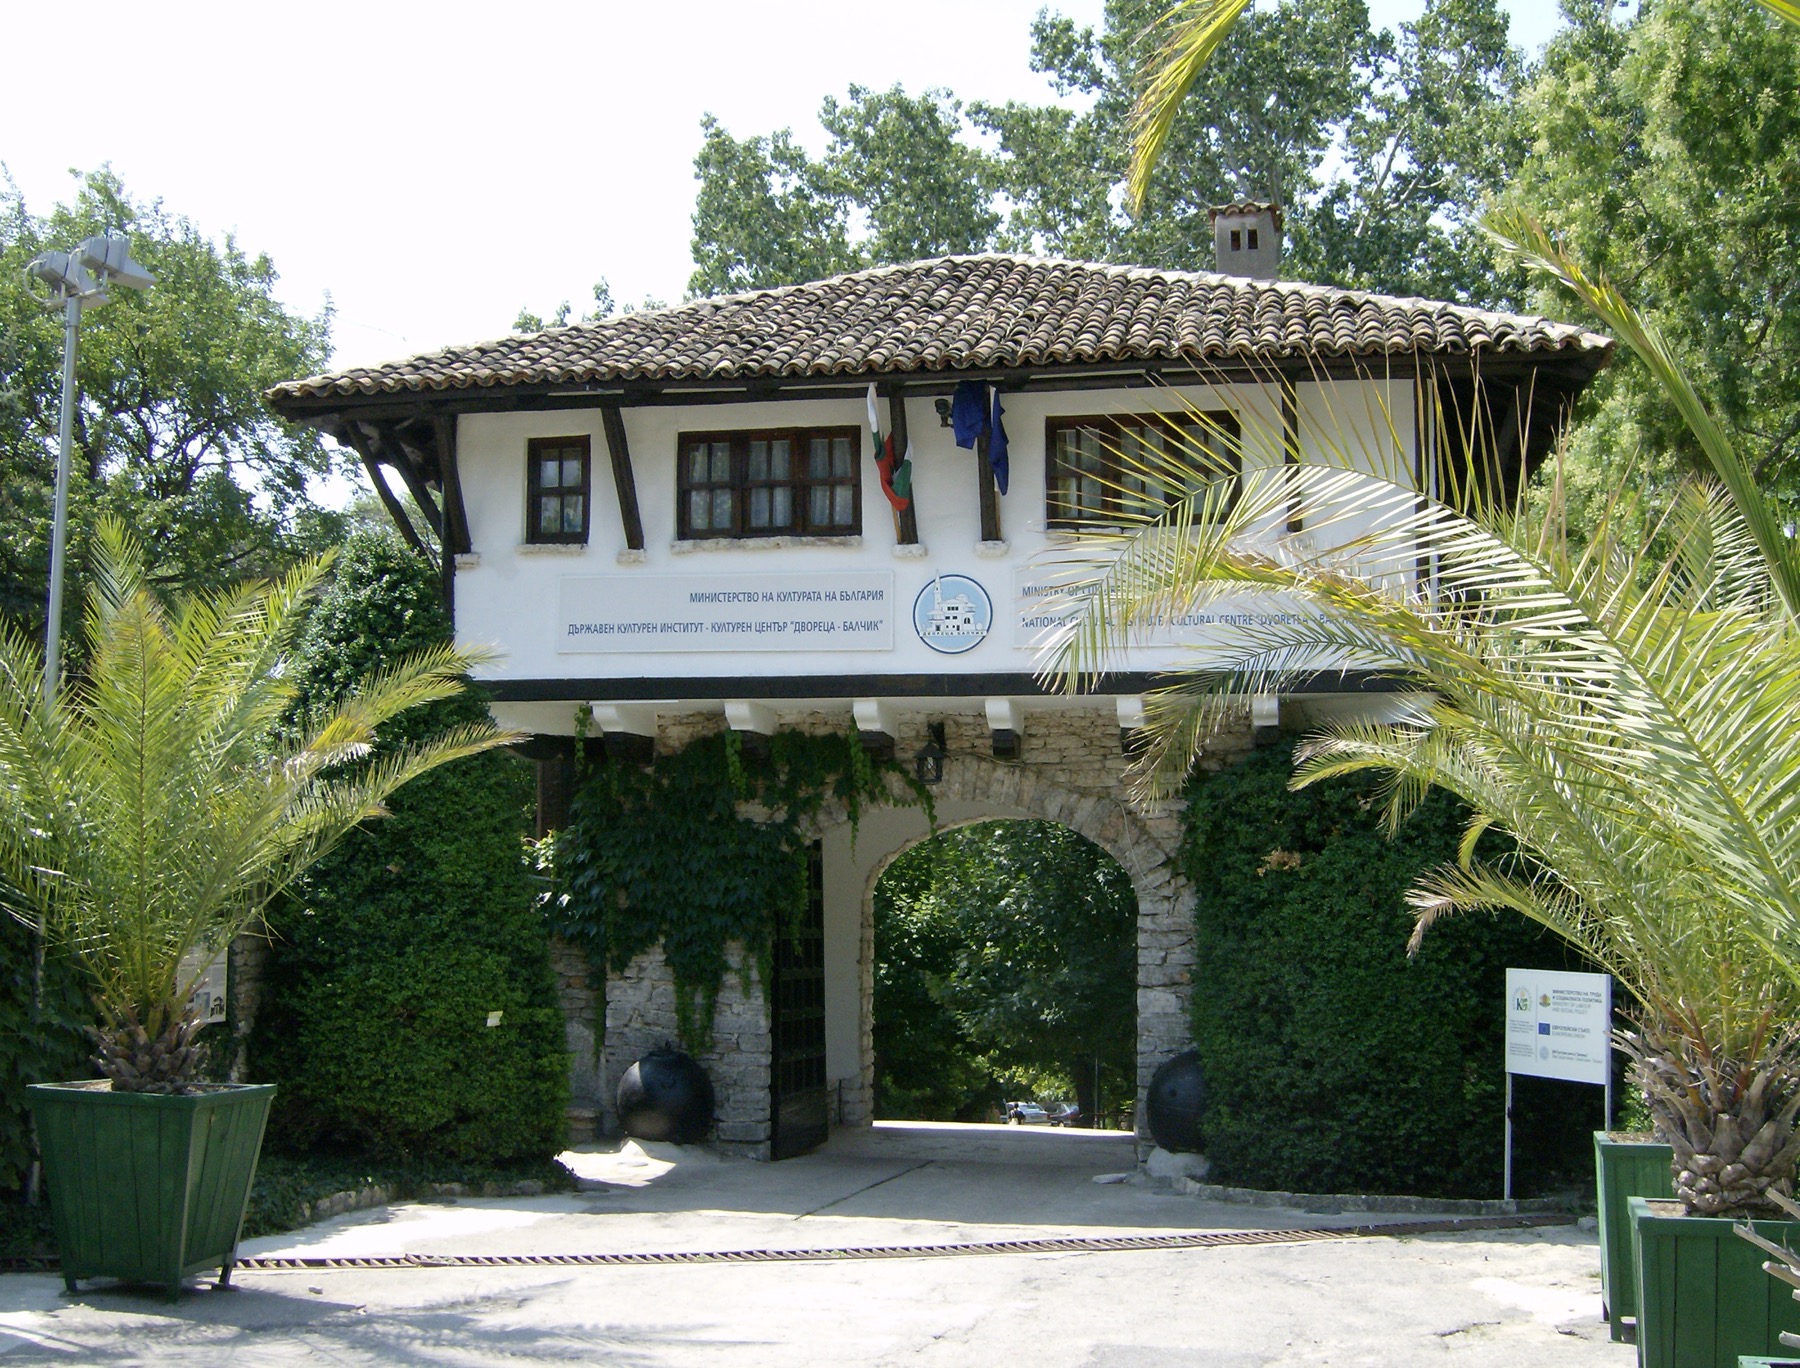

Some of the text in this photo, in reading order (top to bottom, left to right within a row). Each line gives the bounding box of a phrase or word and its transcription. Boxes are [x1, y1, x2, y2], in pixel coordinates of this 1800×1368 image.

[689, 590, 884, 603] МИНИСТЕРСТВО НА КУЛТУРАТА НА БЪЛГАРИЯ
[1022, 616, 1067, 628] NATIONAL
[1219, 614, 1254, 625] CENTRE
[567, 623, 615, 636] ДЪРЖАВЕН
[617, 623, 657, 634] КУЛТУРЕН
[660, 622, 704, 633] ИНСТИТУТ
[711, 621, 751, 633] КУЛТУРЕН
[754, 621, 788, 634] ЦЕНТЪР
